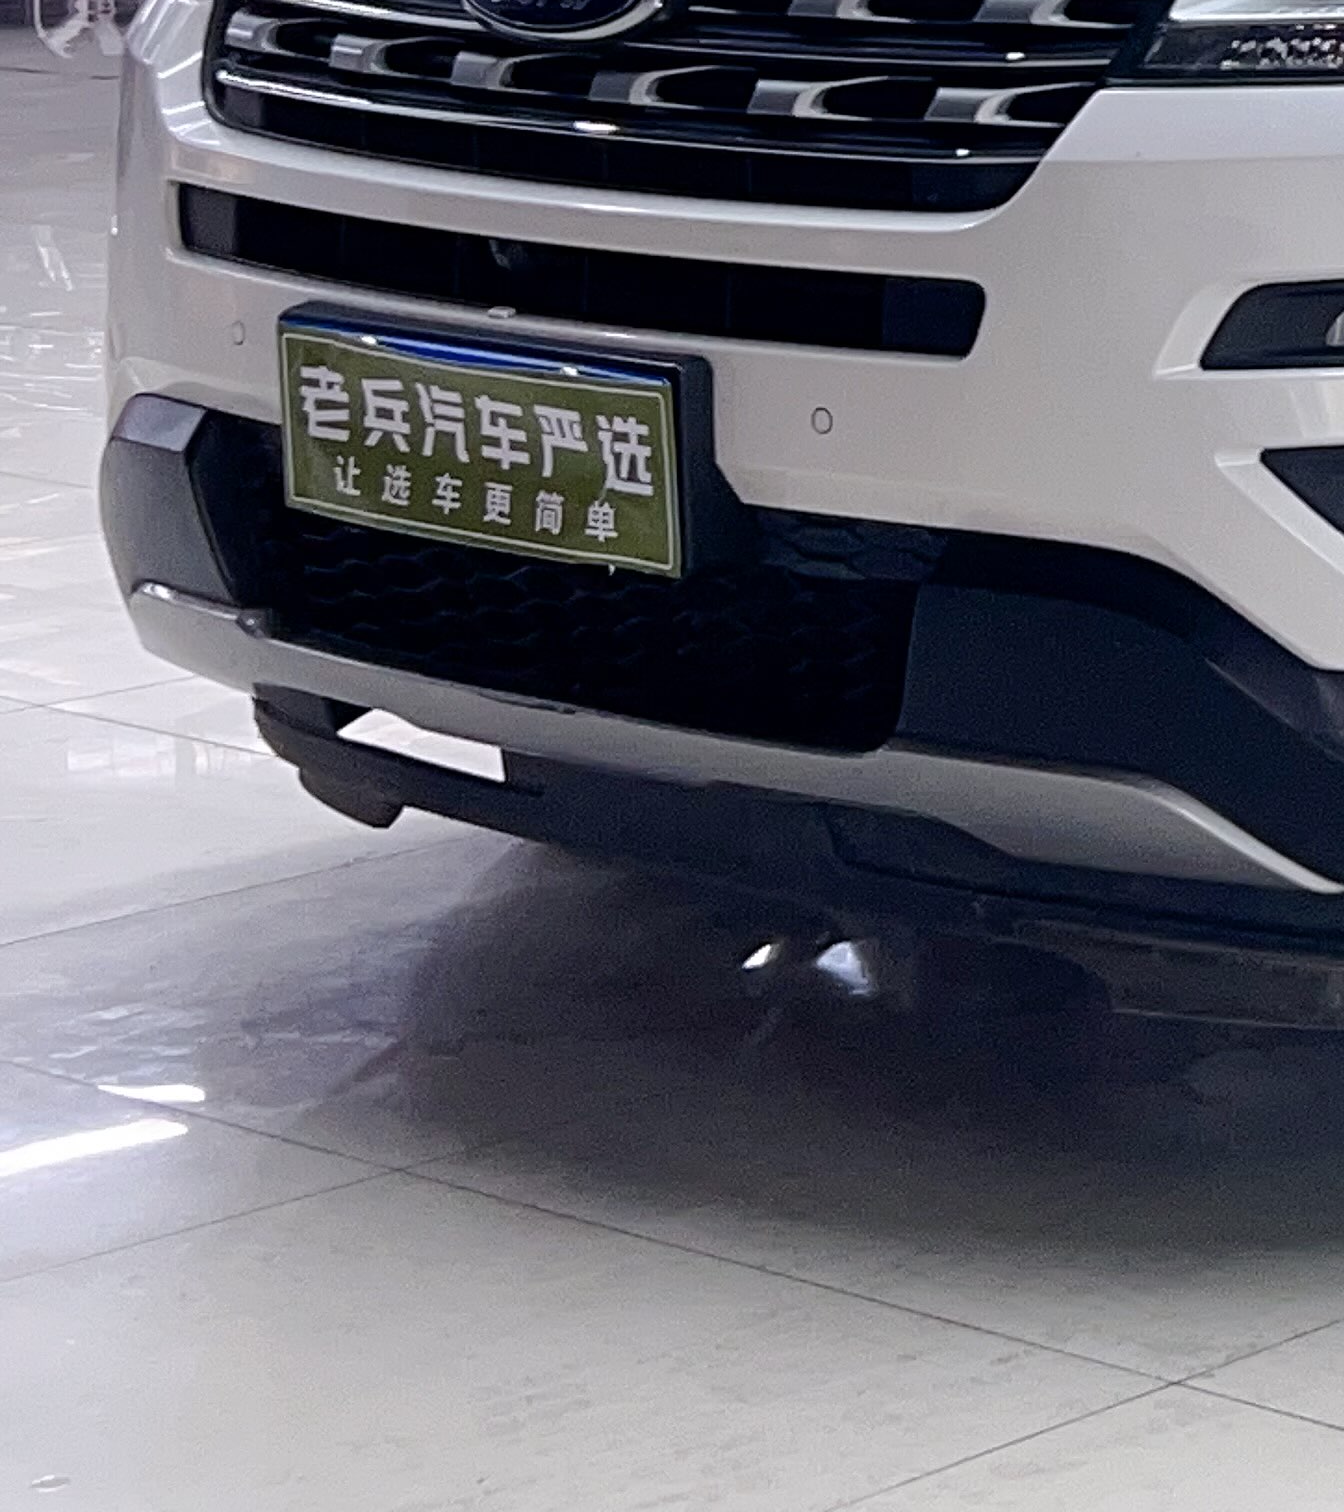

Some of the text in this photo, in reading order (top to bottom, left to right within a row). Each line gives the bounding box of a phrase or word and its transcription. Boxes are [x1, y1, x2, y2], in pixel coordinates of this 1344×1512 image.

[299, 364, 654, 497] 老兵汽车严选
[333, 454, 618, 543] 让选车更简单
